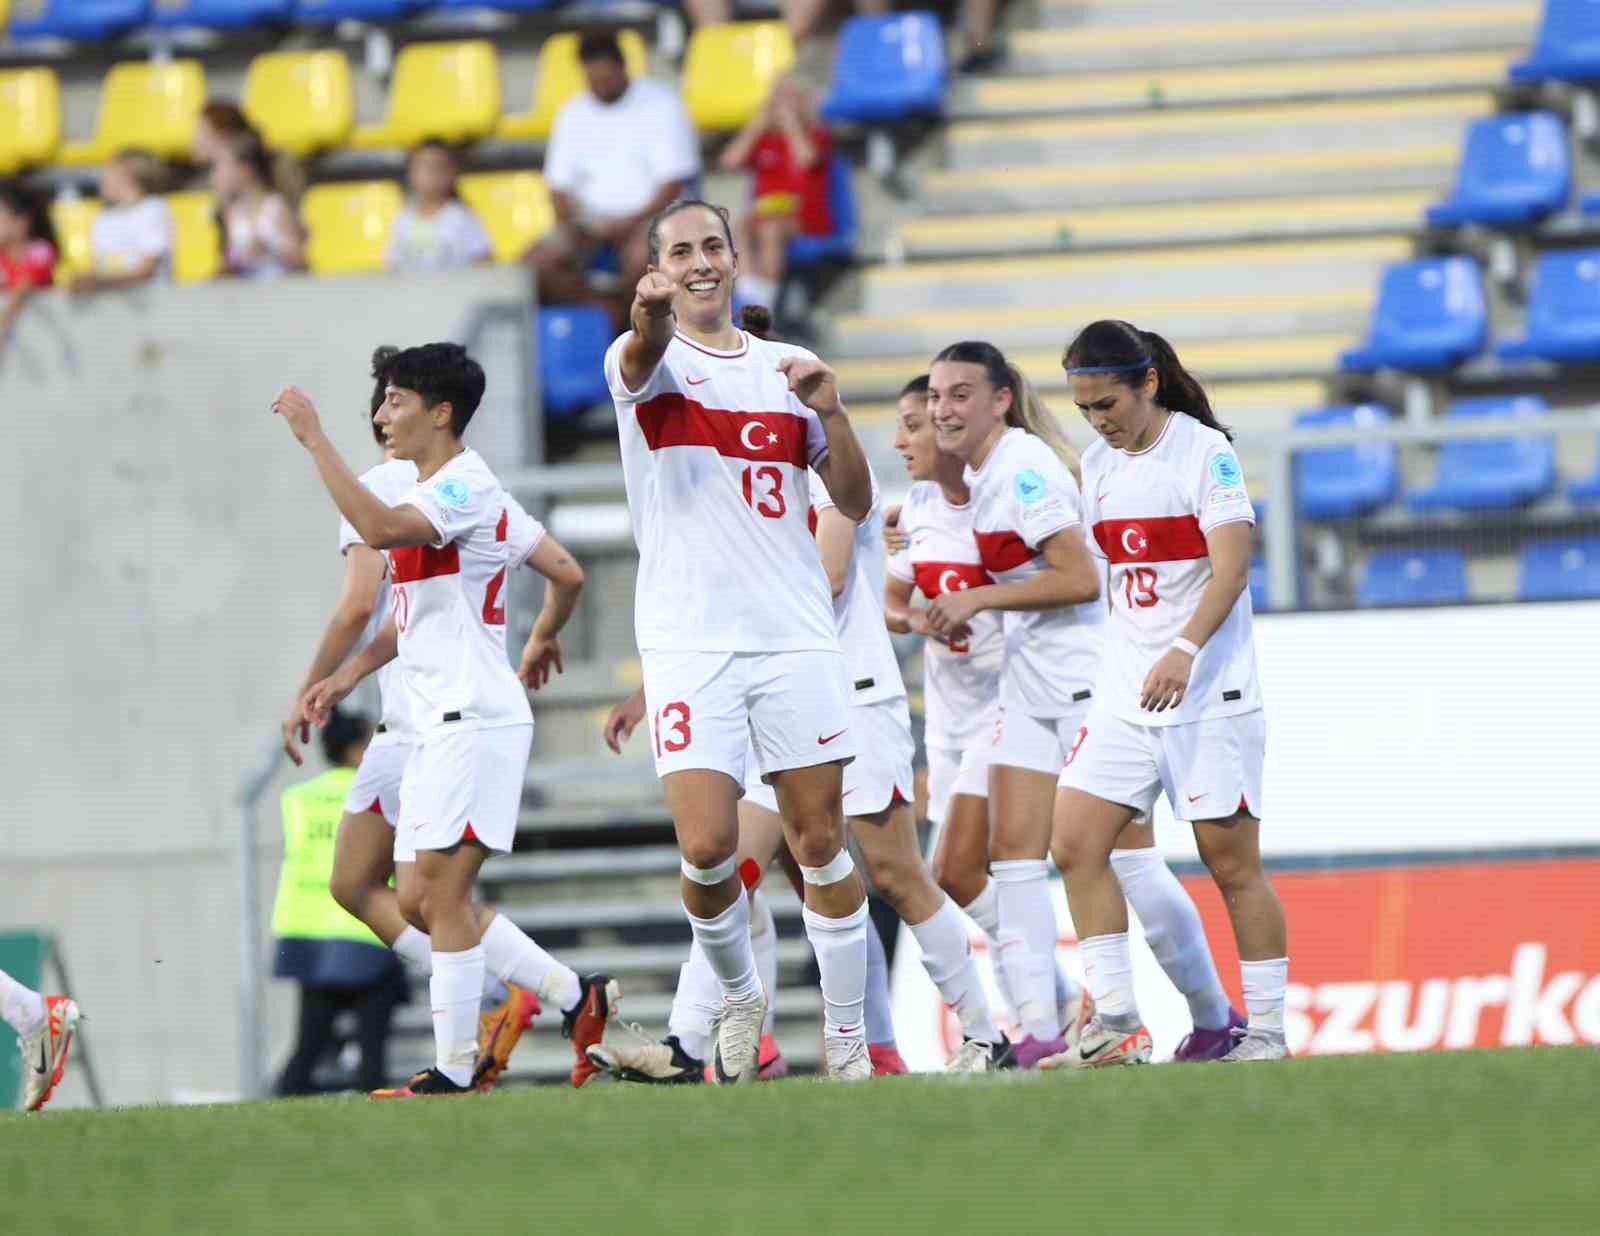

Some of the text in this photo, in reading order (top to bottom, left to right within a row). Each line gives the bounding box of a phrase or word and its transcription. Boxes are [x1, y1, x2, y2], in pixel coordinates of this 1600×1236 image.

[741, 465, 786, 519] 13
[1125, 566, 1159, 609] 19
[655, 701, 692, 759] 13
